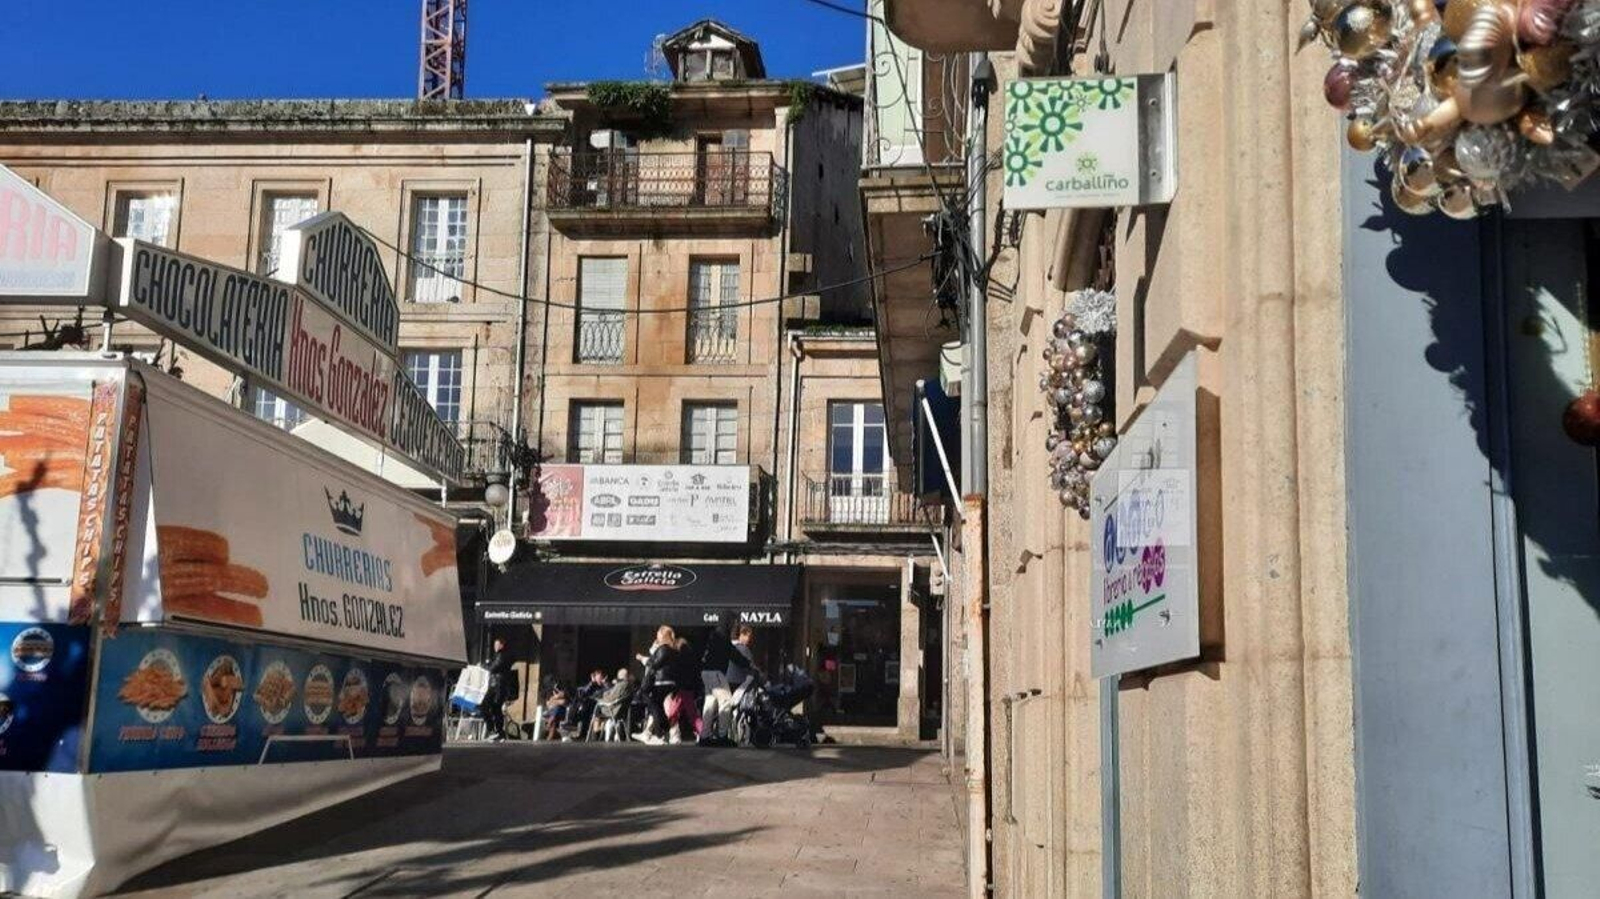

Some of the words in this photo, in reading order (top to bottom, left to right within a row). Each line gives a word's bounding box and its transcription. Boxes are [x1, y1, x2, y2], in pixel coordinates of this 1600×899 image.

[134, 250, 288, 382] CHOCOLATERIA
[303, 221, 396, 346] CHURRERIA
[288, 294, 326, 401] Hnos
[327, 324, 389, 438] Gonzalez
[87, 412, 107, 511] PATATAS
[116, 415, 136, 521] PATATAS
[78, 514, 99, 588] CHIPS
[303, 533, 394, 593] CHURRERIAS
[298, 582, 342, 627] Hnos.
[342, 593, 405, 638] GONZALEZ
[740, 611, 782, 623] NAYLA
